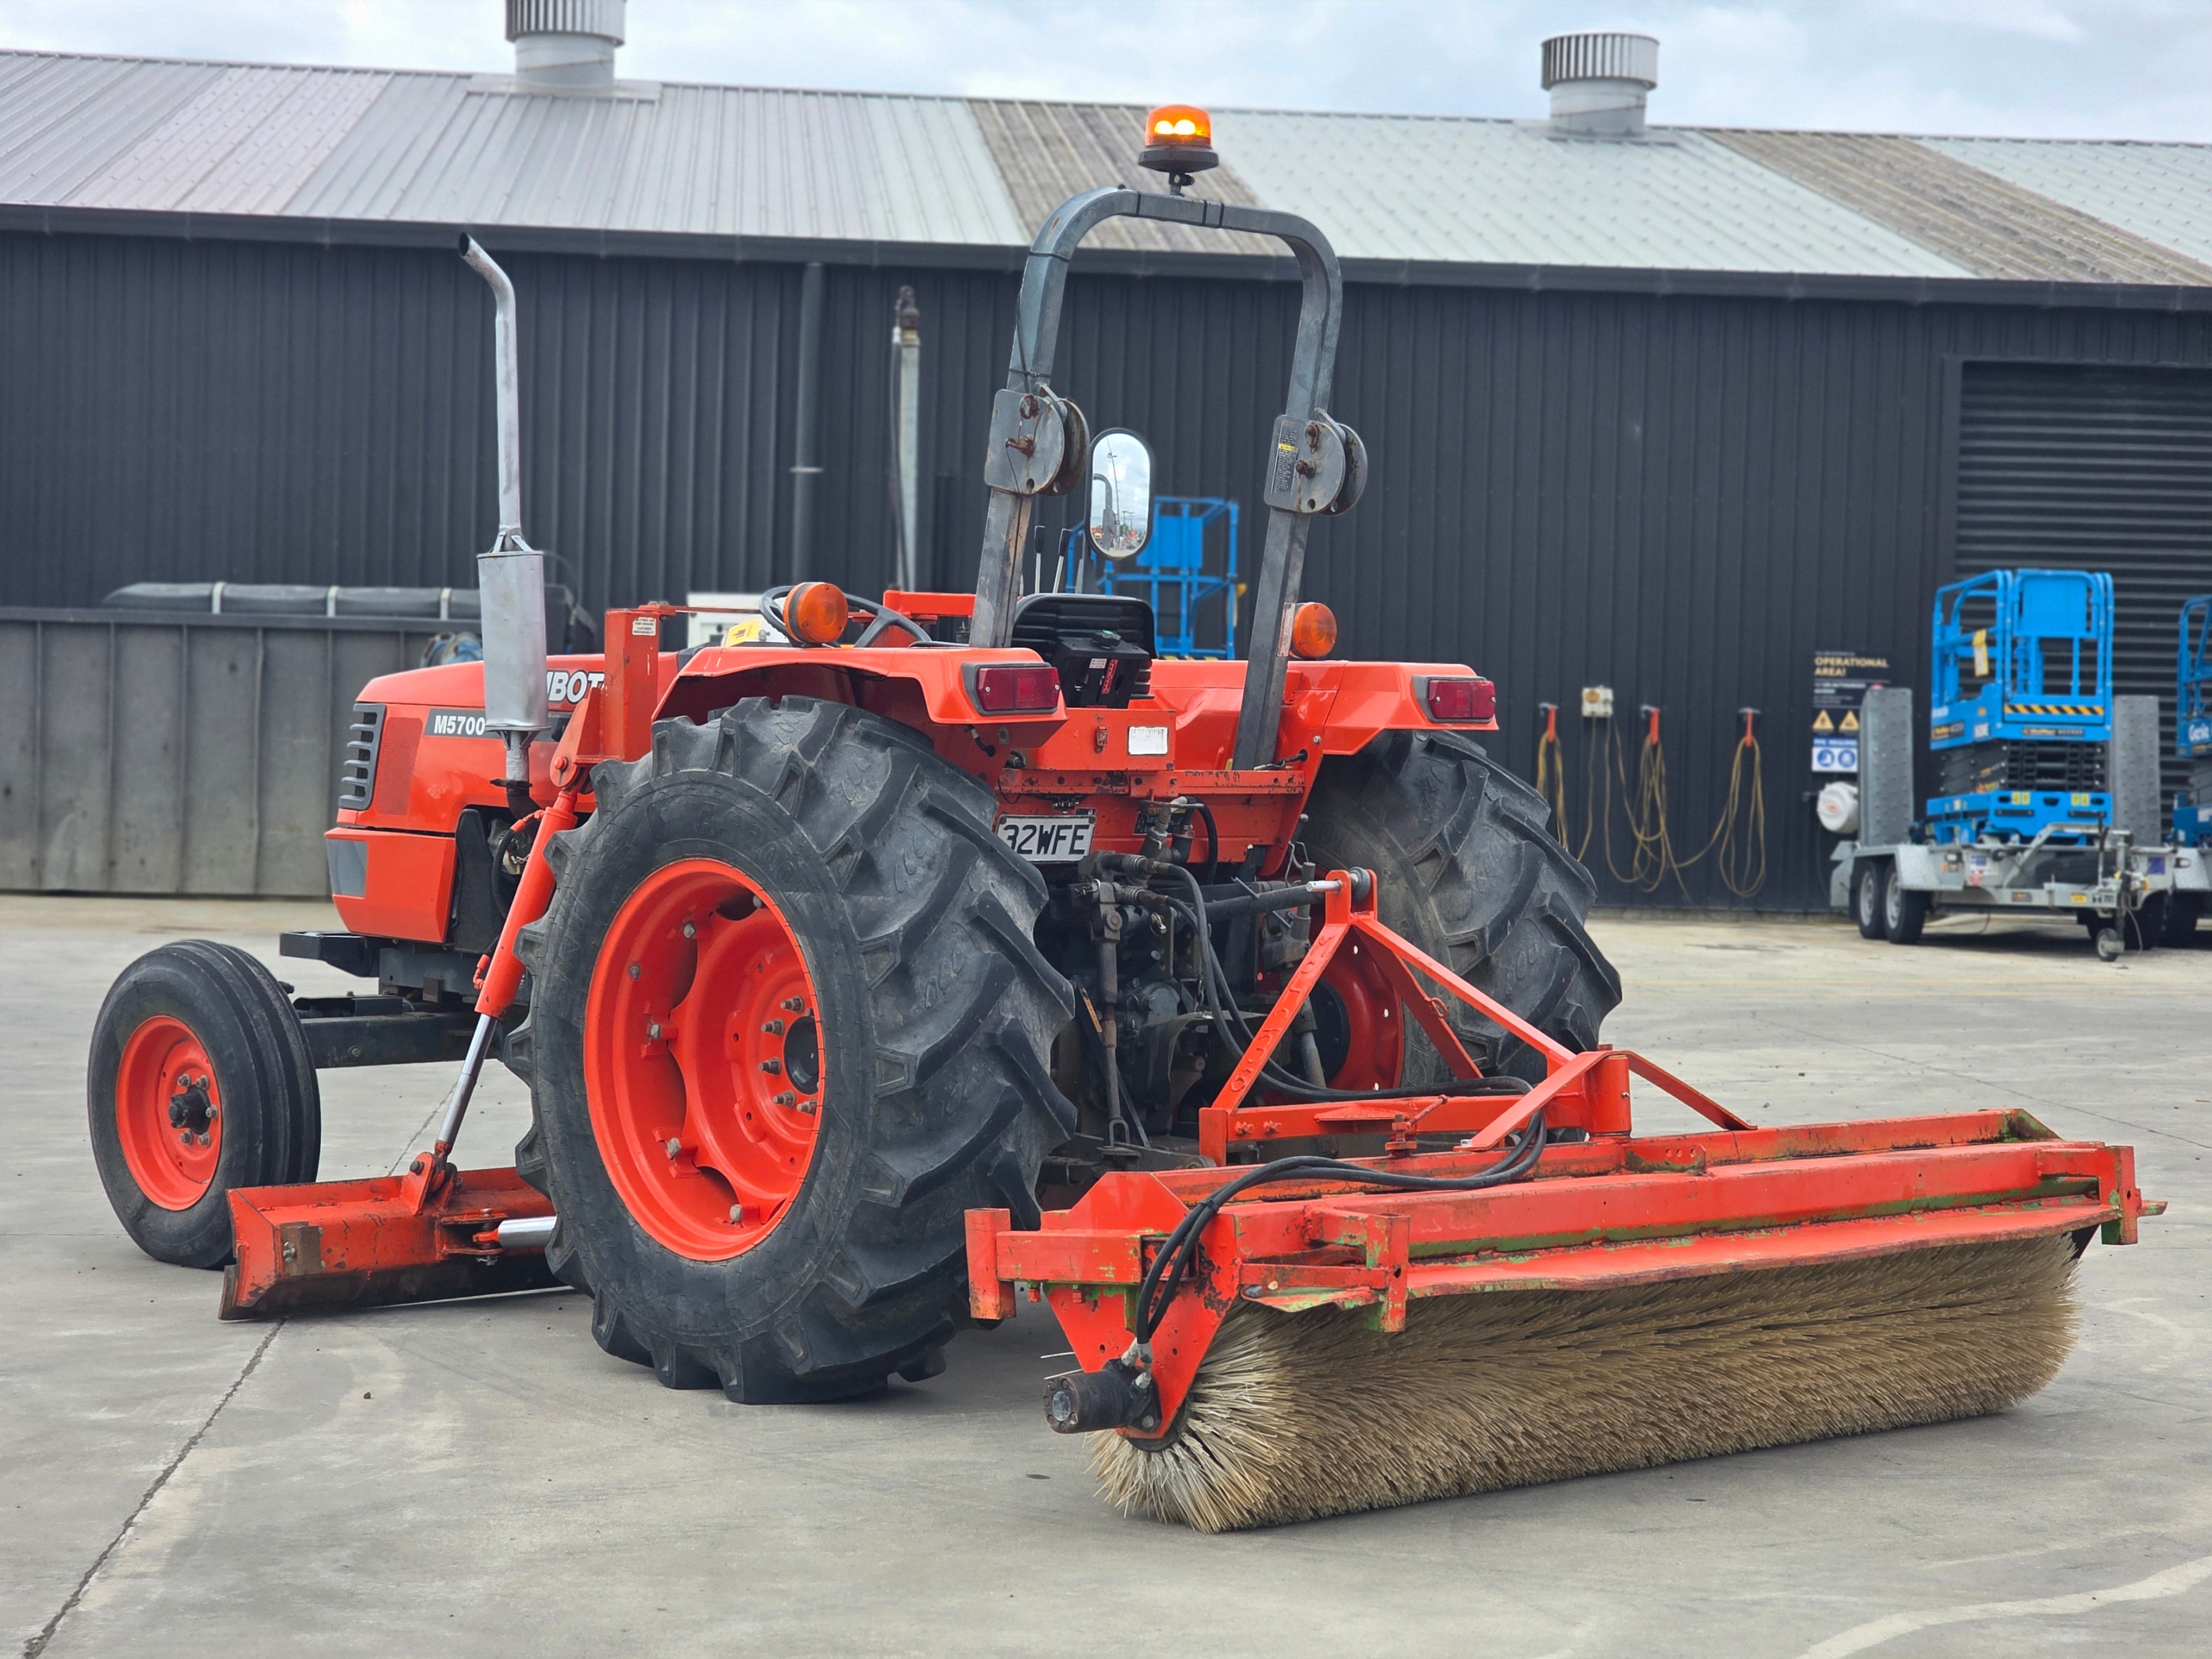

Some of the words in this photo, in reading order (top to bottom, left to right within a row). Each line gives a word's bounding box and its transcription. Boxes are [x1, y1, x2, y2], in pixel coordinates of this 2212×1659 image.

[1814, 657, 1888, 668] OPERATIONAL
[1814, 667, 1846, 676] AREA!
[546, 671, 605, 703] BOT
[434, 715, 485, 736] M5700
[1003, 825, 1089, 854] 32WFE
